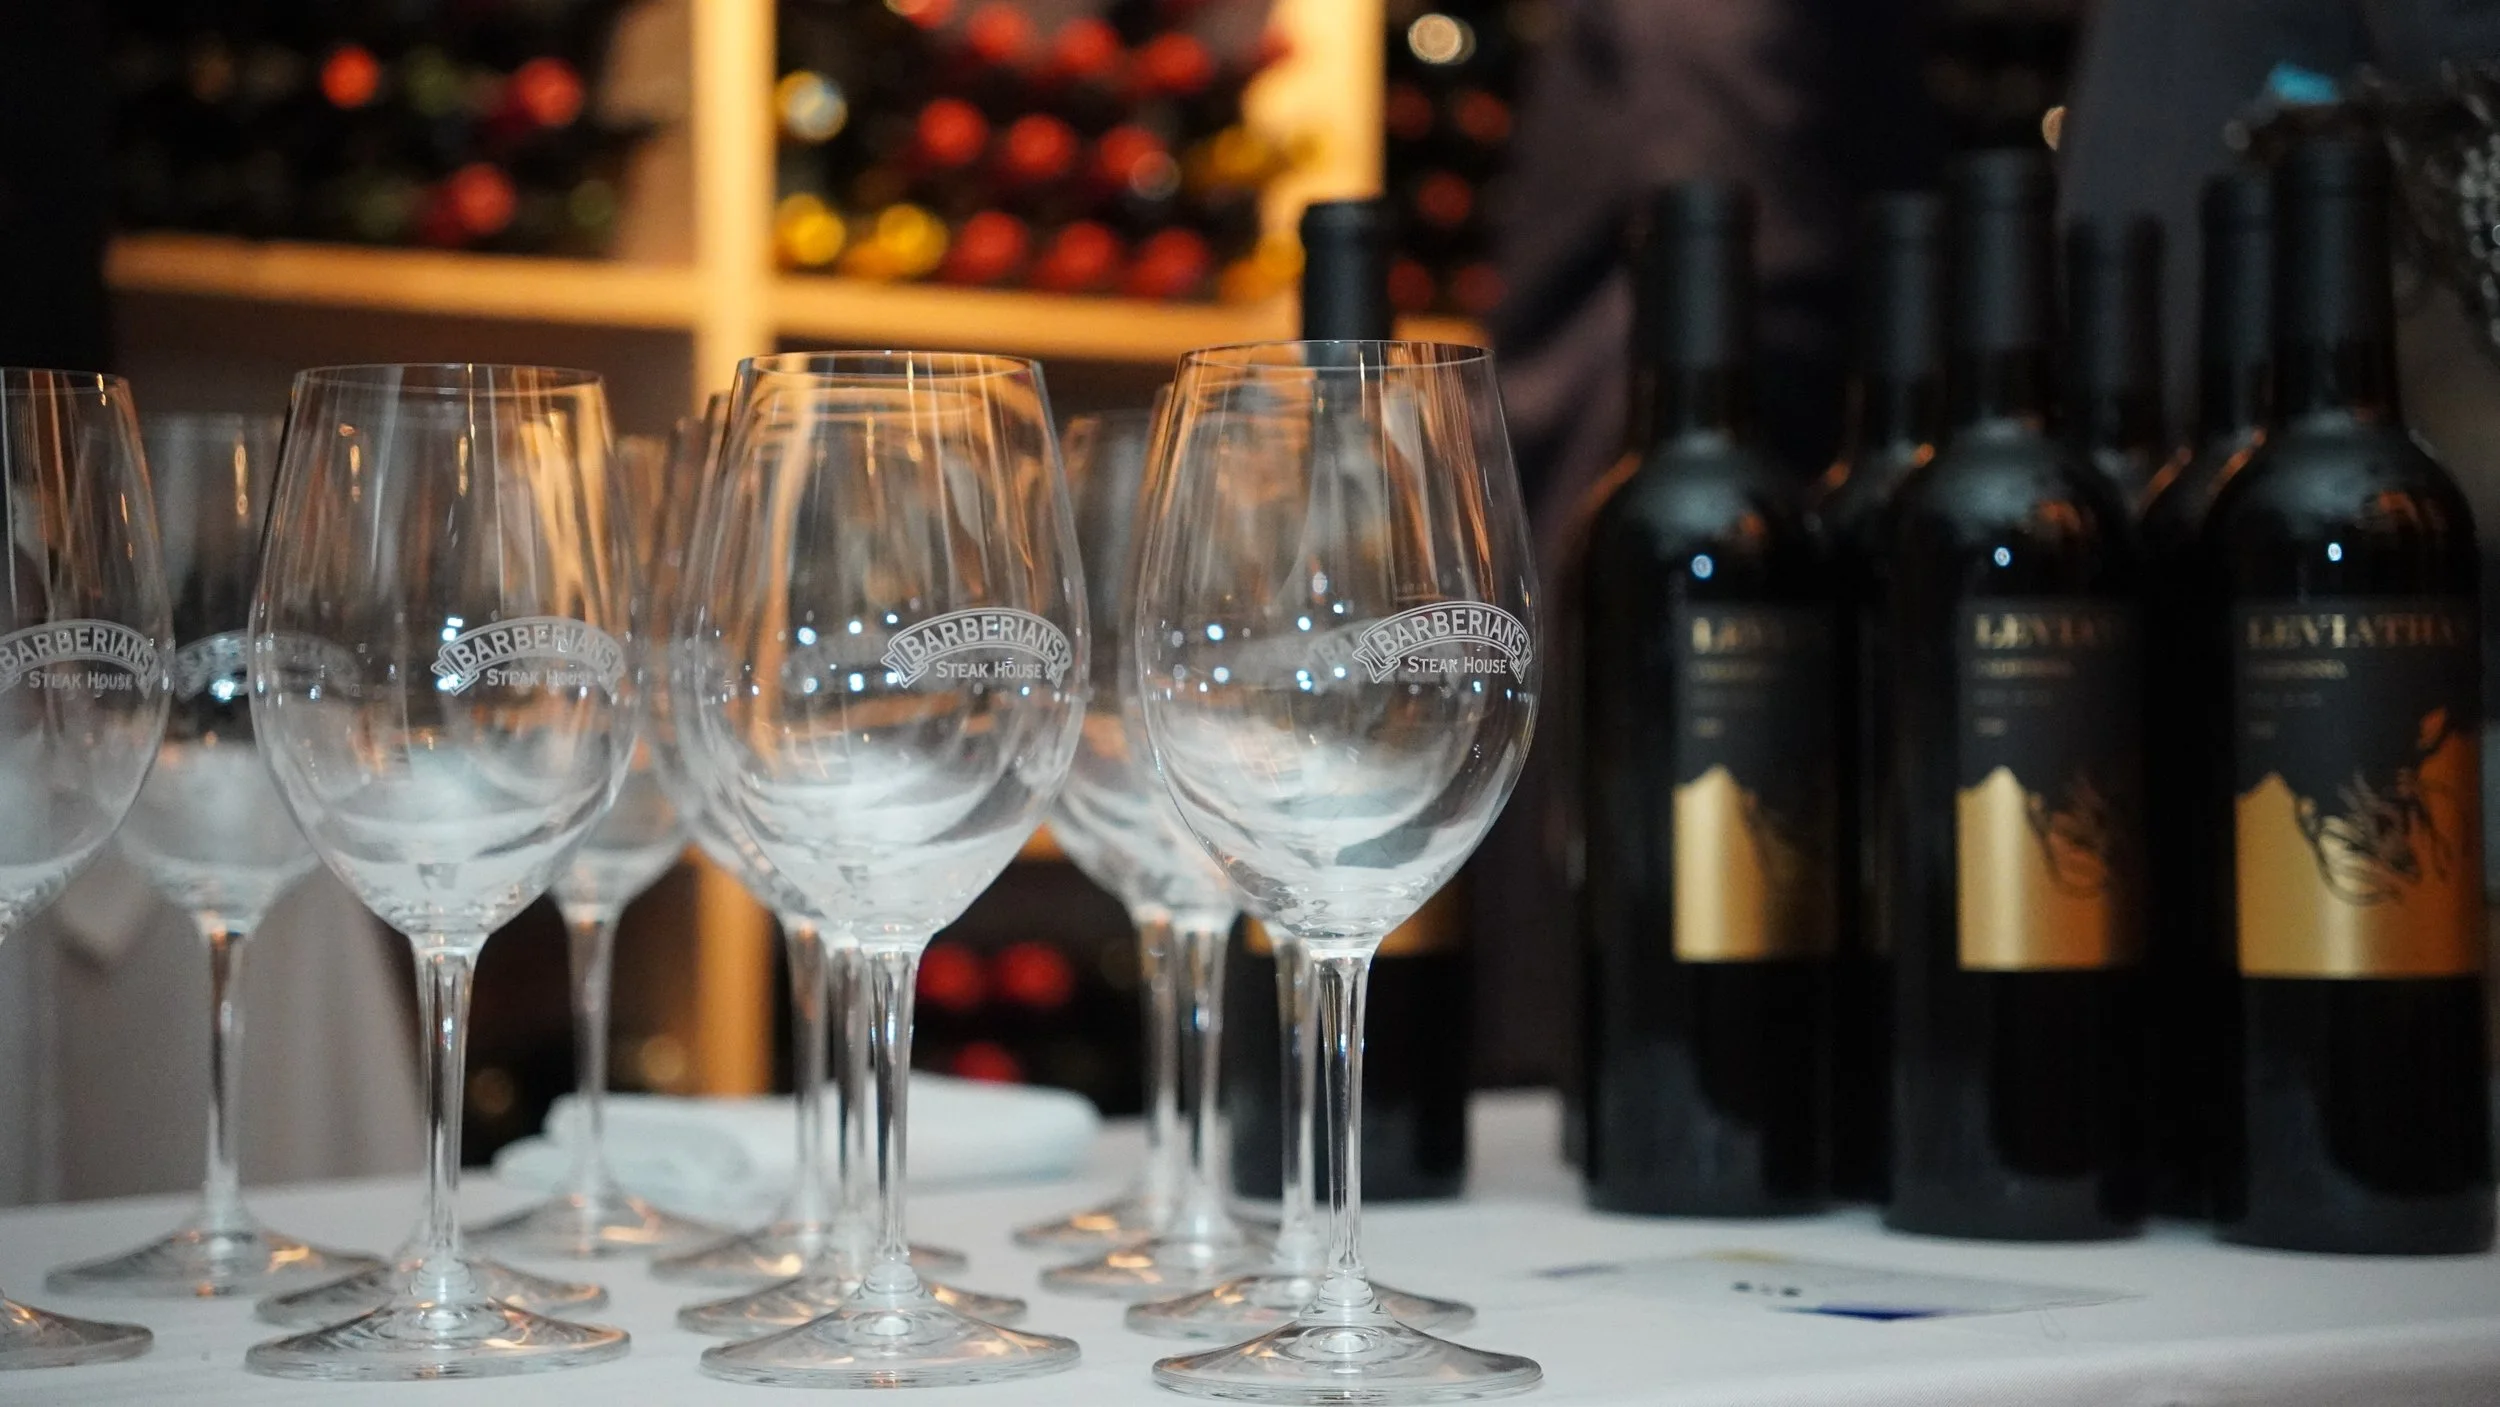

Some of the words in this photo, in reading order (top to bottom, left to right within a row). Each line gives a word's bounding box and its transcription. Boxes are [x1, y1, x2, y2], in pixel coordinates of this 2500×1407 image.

[1371, 608, 1526, 657] BARBERIAN'S
[935, 660, 989, 679] STEAK
[994, 661, 1042, 679] HOUSE
[1407, 655, 1459, 674] STEAK
[1463, 656, 1508, 675] HOUSE
[28, 670, 83, 689] STEAK
[87, 670, 133, 691] HOUSE
[486, 668, 539, 687] STEAK
